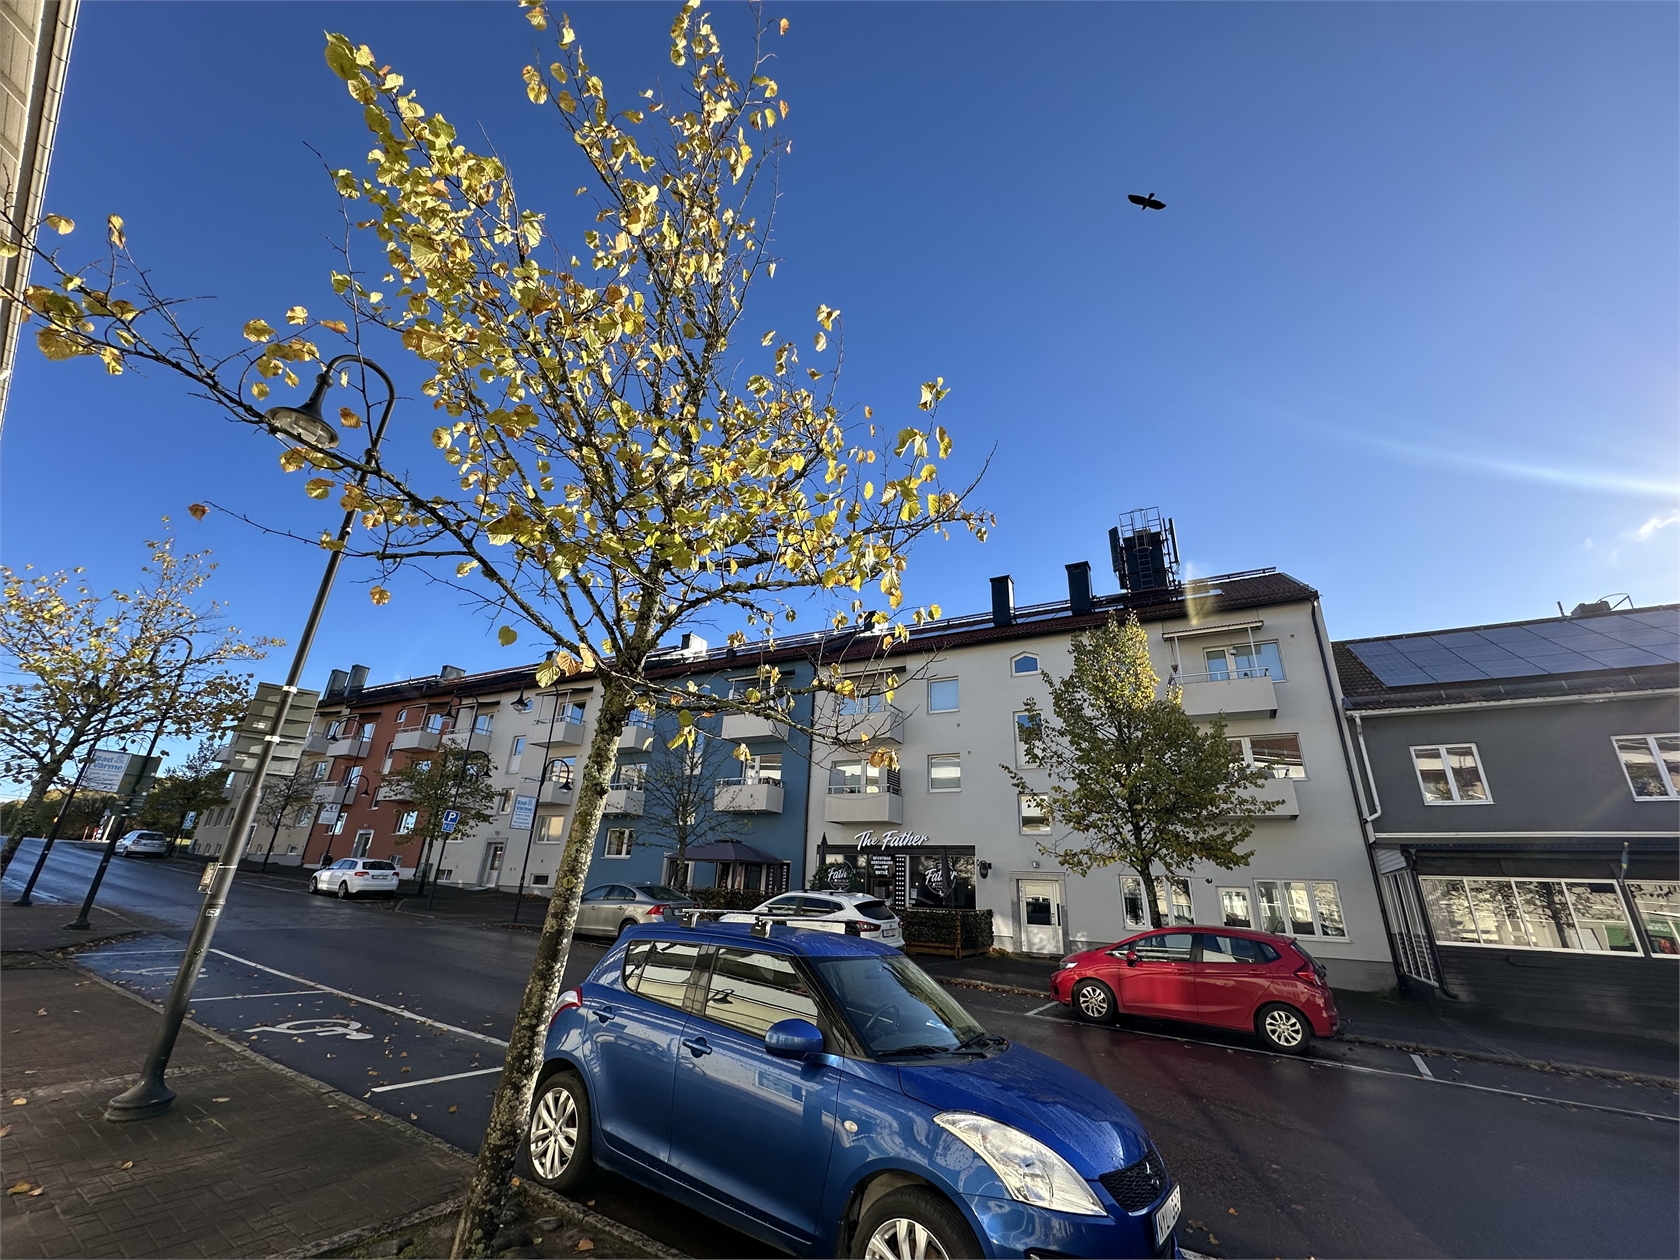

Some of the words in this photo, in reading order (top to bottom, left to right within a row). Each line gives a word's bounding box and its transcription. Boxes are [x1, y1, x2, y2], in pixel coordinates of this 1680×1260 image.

[95, 755, 114, 763] Bad
[114, 754, 125, 764] &
[854, 830, 880, 851] The
[881, 830, 929, 851] Father
[925, 868, 957, 884] Fatr
